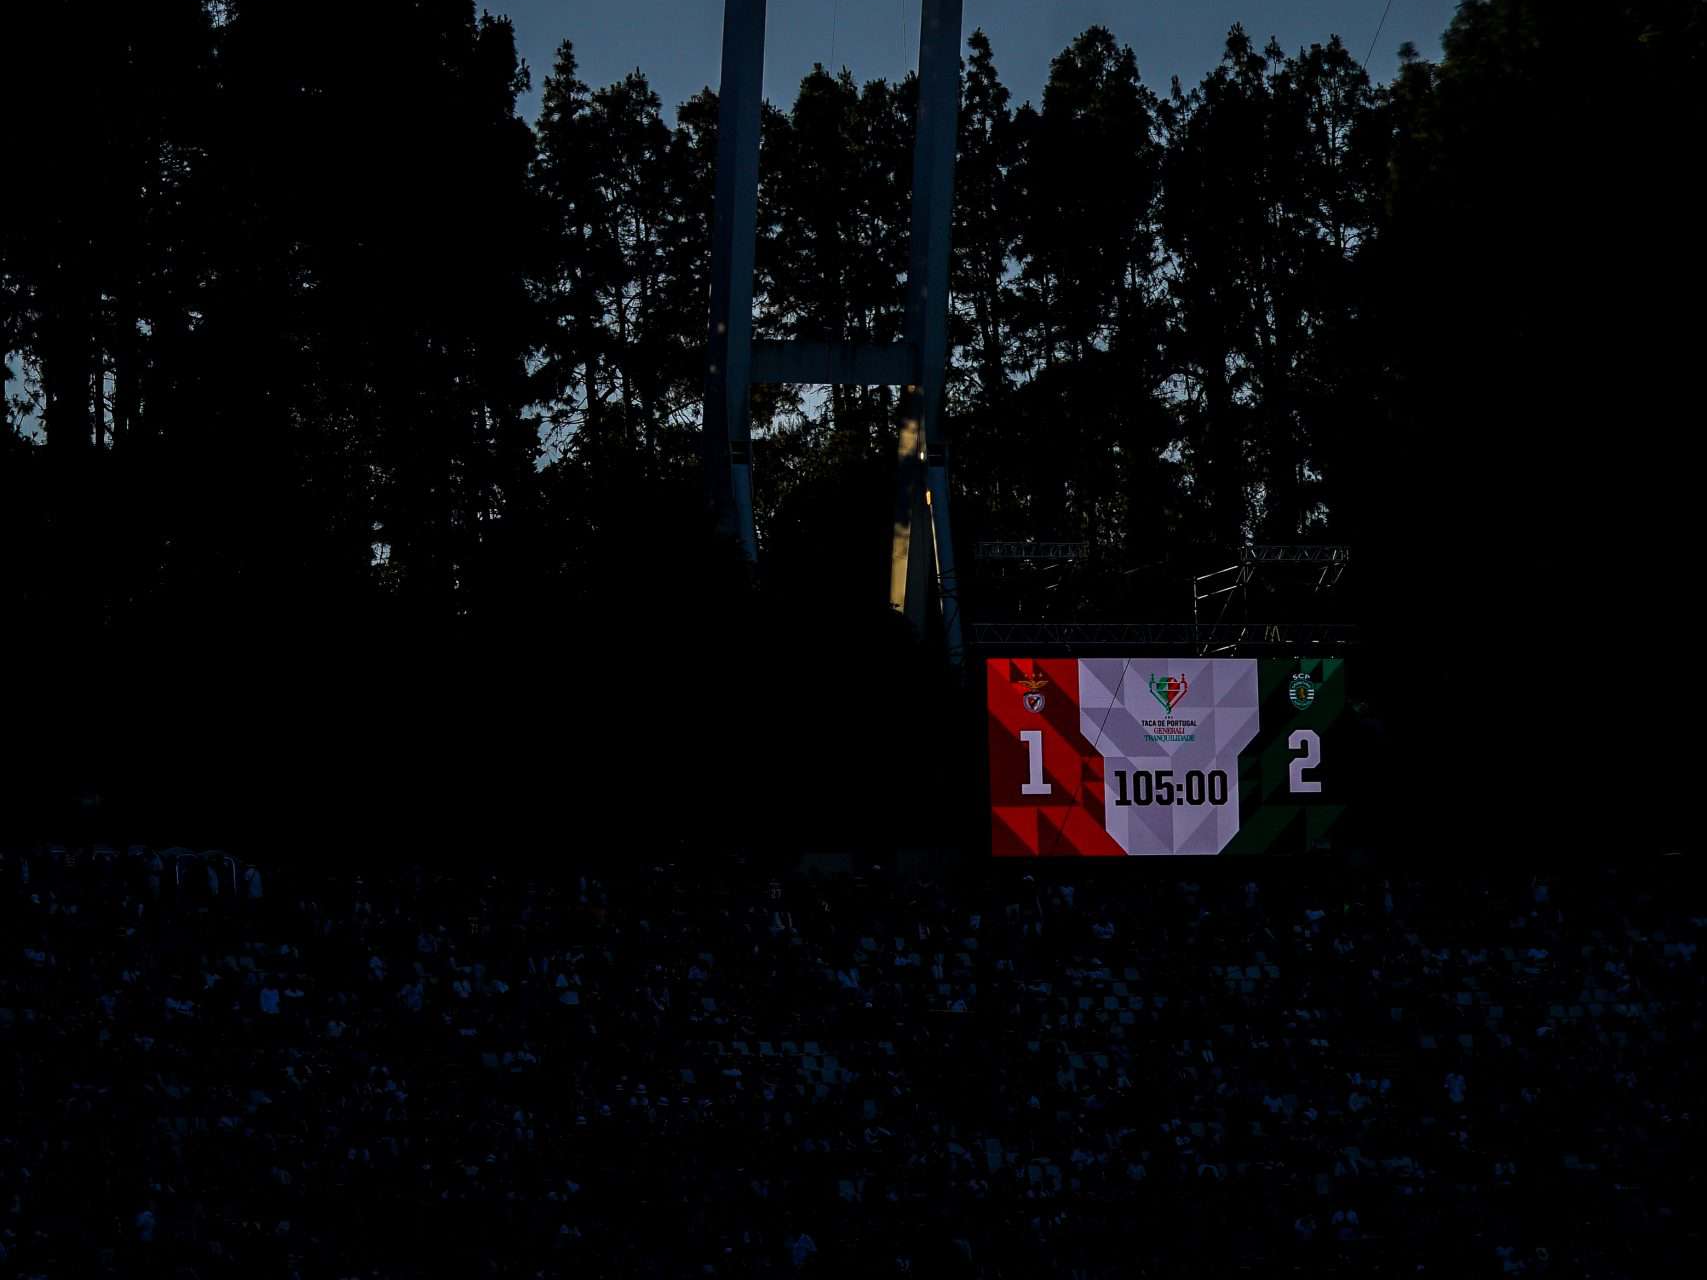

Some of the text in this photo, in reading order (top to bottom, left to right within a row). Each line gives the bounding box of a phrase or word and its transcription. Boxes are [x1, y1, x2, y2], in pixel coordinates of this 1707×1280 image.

[1157, 719, 1166, 727] DE
[1166, 719, 1197, 727] PORTUGAL
[1019, 730, 1052, 795] 1
[1288, 729, 1322, 793] 2
[1114, 769, 1229, 806] 105:00
